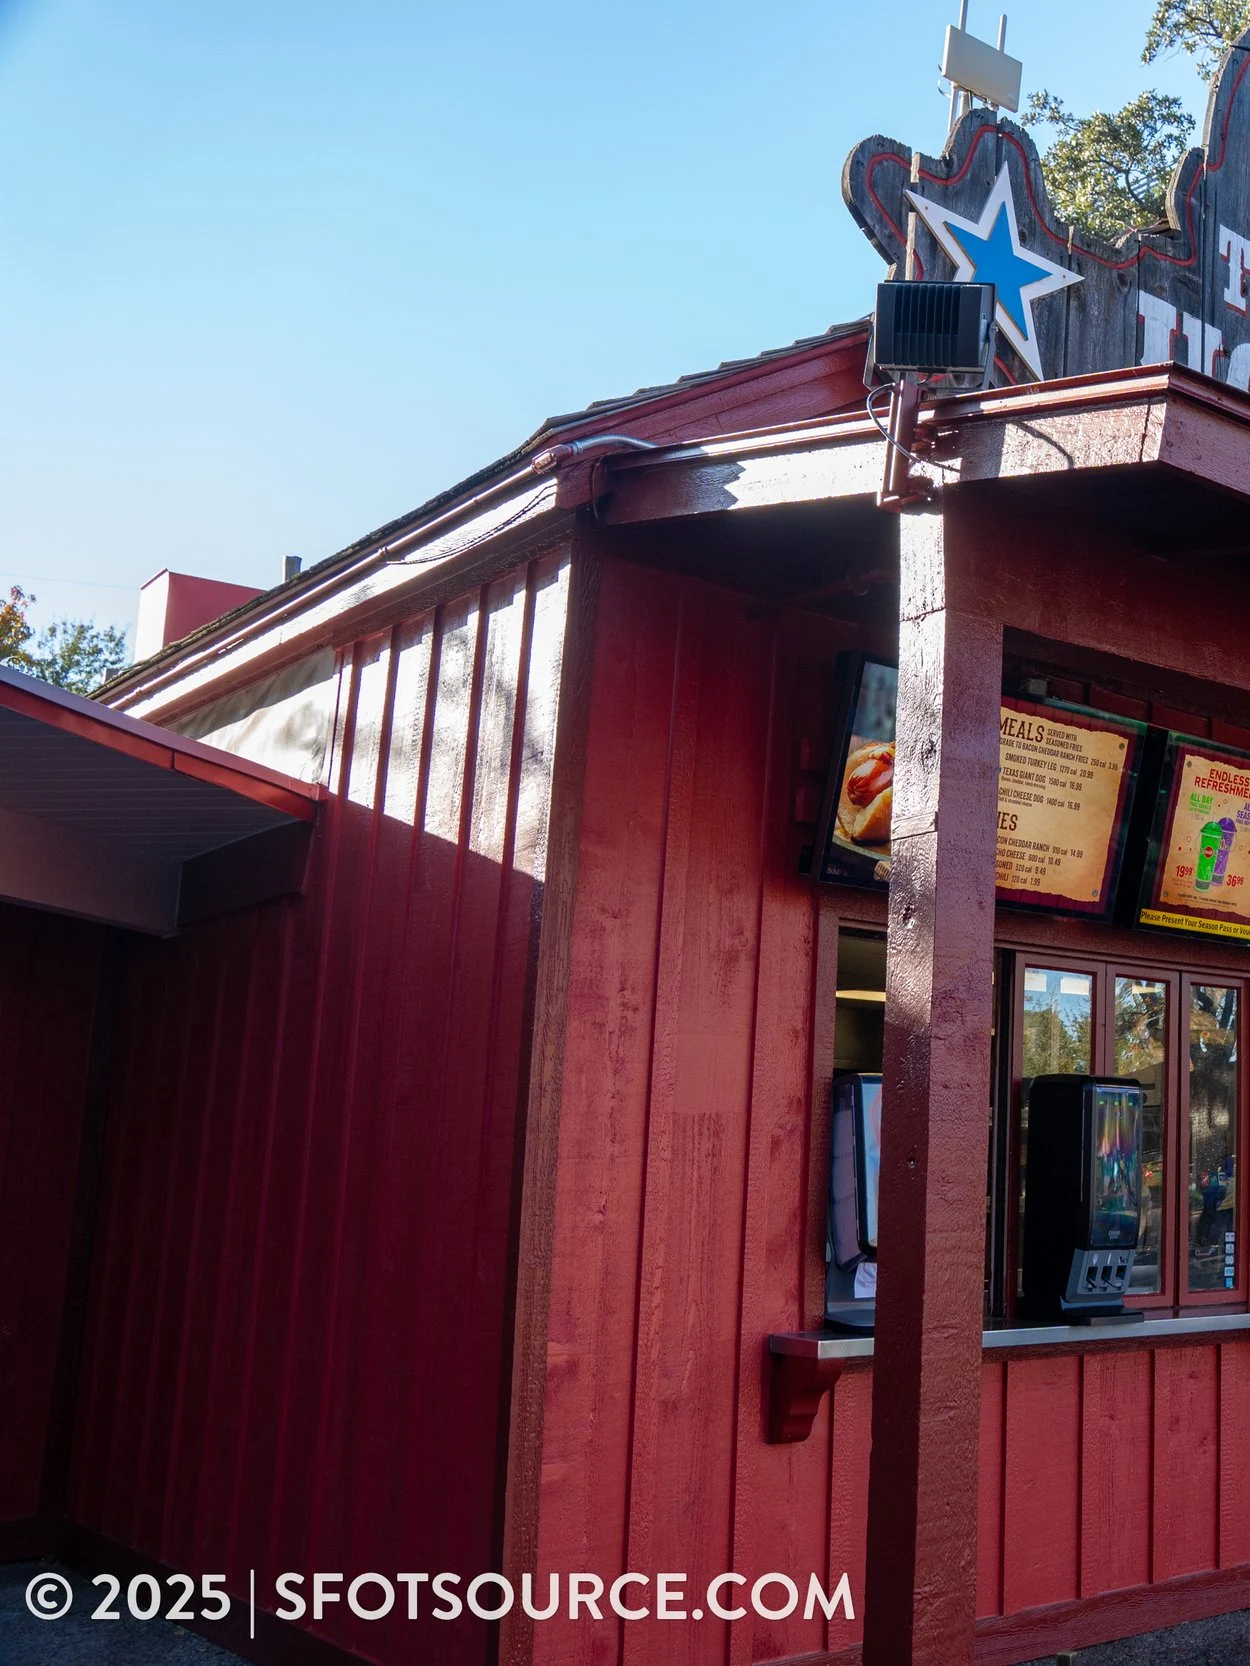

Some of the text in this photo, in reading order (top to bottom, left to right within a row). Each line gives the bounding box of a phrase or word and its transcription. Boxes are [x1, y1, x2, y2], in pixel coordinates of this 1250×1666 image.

[1047, 728, 1065, 739] SERVED
[1000, 737, 1016, 748] GRADE
[1022, 742, 1039, 753] BACON
[1038, 746, 1060, 757] CHEDDAR
[1060, 750, 1076, 761] RANCH
[1045, 737, 1069, 750] SEASONED
[1005, 752, 1027, 765] SMOKED
[1027, 757, 1048, 770] TURKEY
[1047, 762, 1058, 771] LEG
[1003, 766, 1020, 778] TEXAS
[1019, 770, 1036, 781] GIANT
[1035, 773, 1047, 784] DOG
[1209, 768, 1250, 788] ENDLESS
[1013, 790, 1034, 801] CHEESE
[1033, 793, 1044, 803] DOG
[997, 811, 1018, 831] IES
[997, 835, 1009, 845] CON
[1008, 837, 1033, 849] CHEDDAR
[1032, 842, 1051, 853] RANCH
[1006, 849, 1027, 861] CHEESE
[1140, 911, 1161, 922] Please
[1162, 914, 1184, 926] Present
[1185, 917, 1197, 928] Your
[1197, 920, 1219, 930] Season
[1220, 924, 1232, 934] Pass
